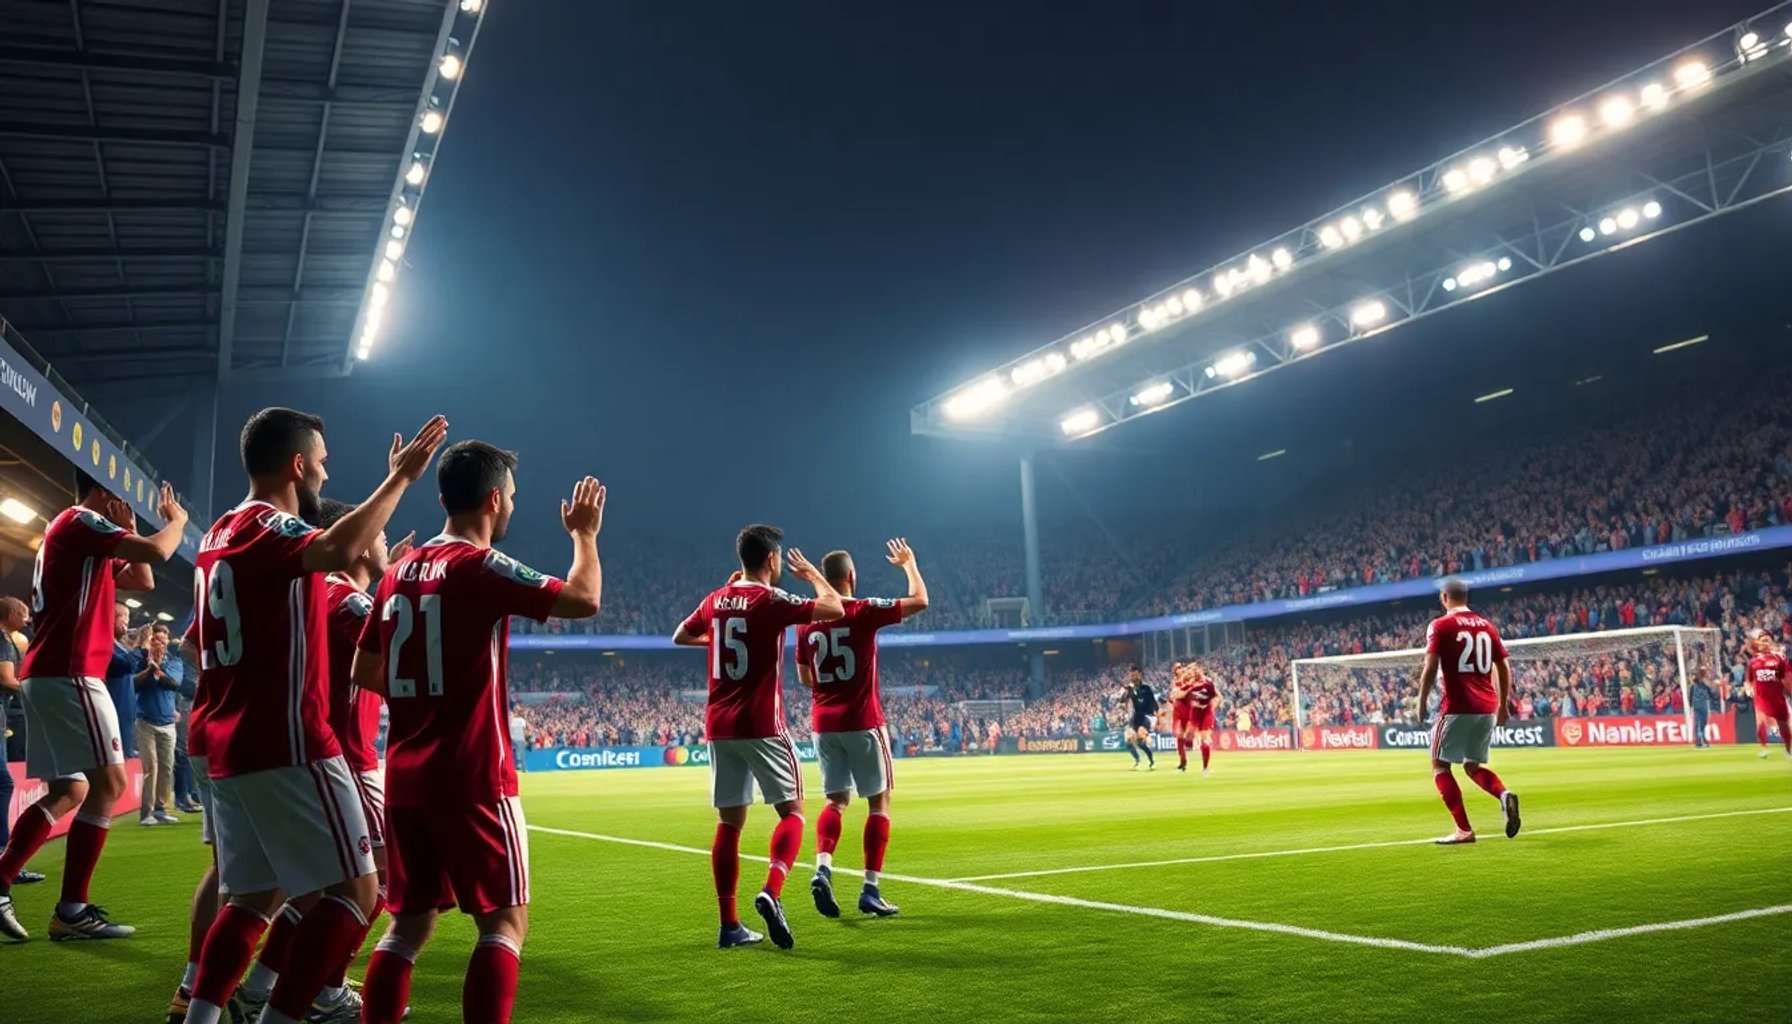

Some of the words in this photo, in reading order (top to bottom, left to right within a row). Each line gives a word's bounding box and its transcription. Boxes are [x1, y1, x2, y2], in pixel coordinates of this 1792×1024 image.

[382, 594, 444, 697] 21
[712, 617, 748, 680] 15
[808, 627, 855, 683] 25
[1456, 631, 1492, 674] 20
